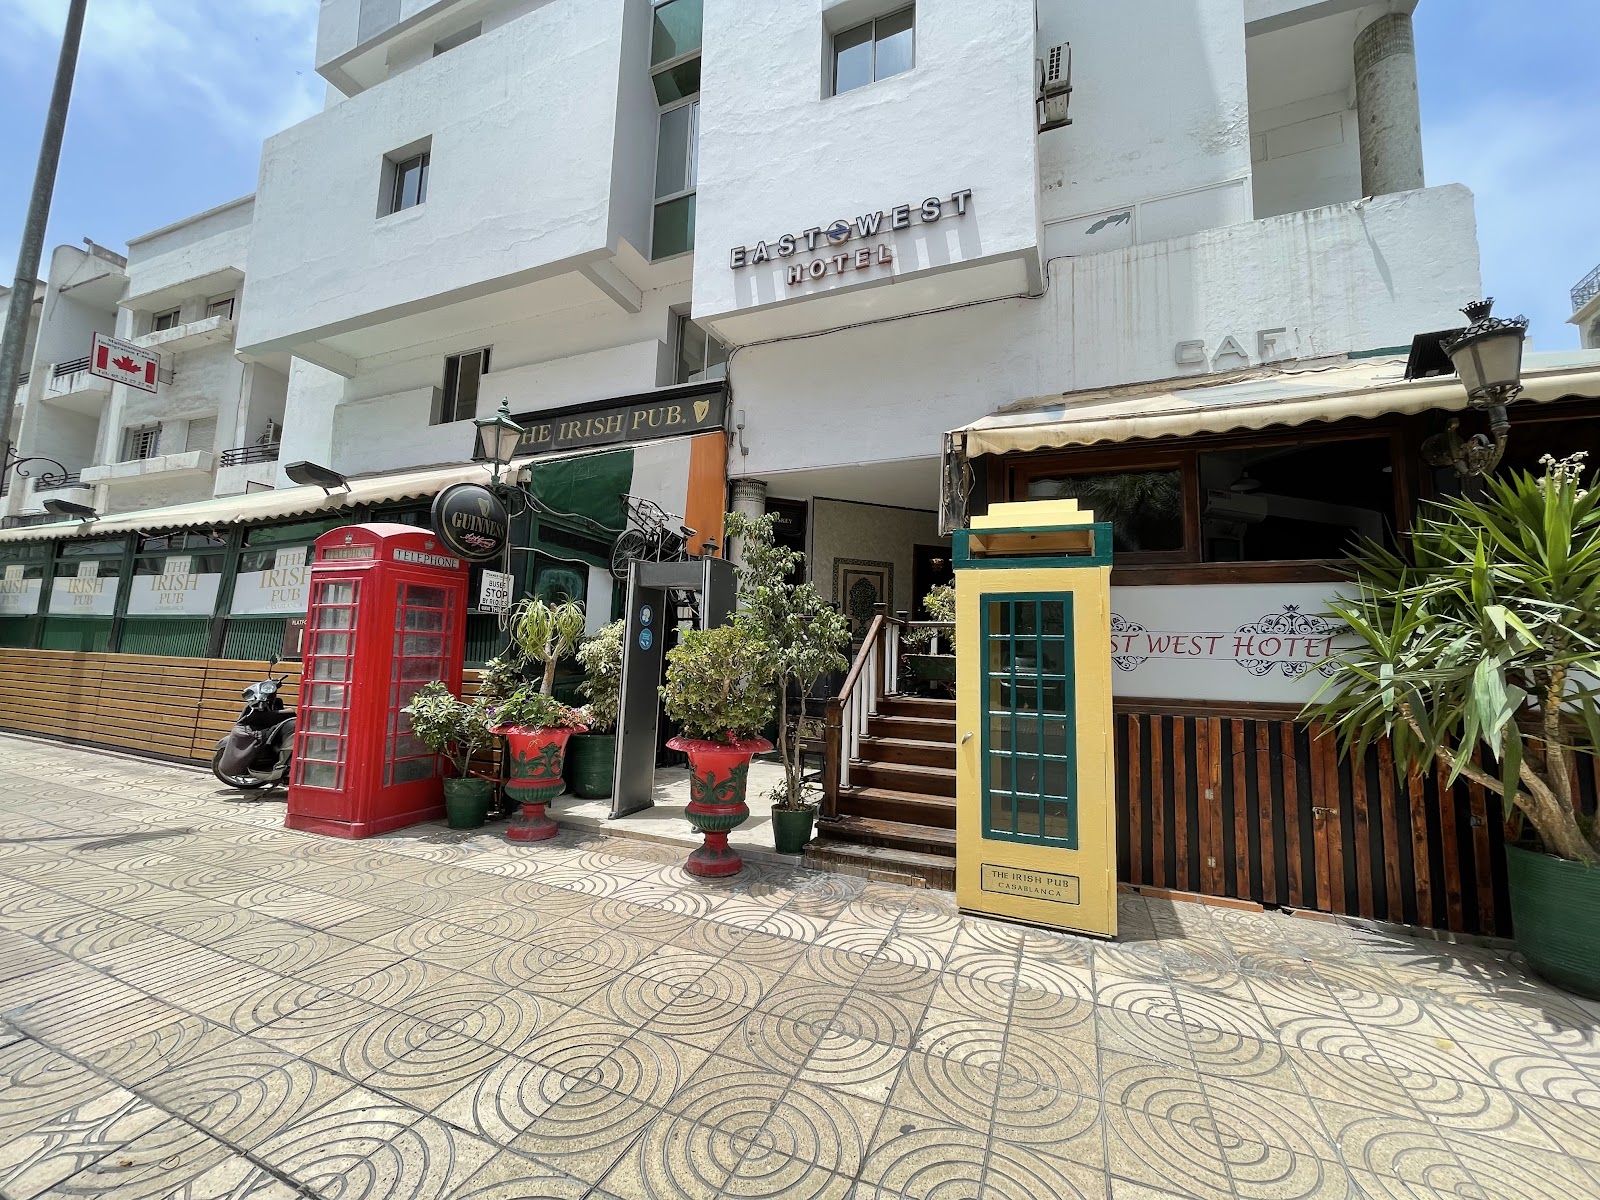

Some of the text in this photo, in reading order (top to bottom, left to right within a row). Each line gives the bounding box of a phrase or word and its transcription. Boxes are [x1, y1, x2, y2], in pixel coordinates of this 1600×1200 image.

[730, 188, 972, 270] EAST WEST
[787, 244, 892, 285] HOTEL
[136, 352, 158, 363] Canada
[520, 424, 552, 445] HE
[557, 414, 624, 441] IRISH
[451, 511, 506, 539] GUINNESS
[276, 552, 305, 566] THE
[327, 547, 373, 559] TELEPHONE
[395, 549, 457, 568] TELEPHONE
[79, 567, 97, 577] THE
[166, 561, 189, 573] THE
[0, 580, 28, 594] RISH
[67, 578, 104, 594] IRISH
[151, 574, 199, 591] IRISH
[159, 592, 184, 604] PUB
[271, 588, 301, 602] PUB
[486, 588, 507, 598] STOP
[73, 595, 93, 606] PUB
[1110, 633, 1140, 654] ST
[1147, 634, 1225, 656] WEST
[992, 870, 1069, 888] THE IRISH PUB
[998, 882, 1062, 897] CASABLANCA
